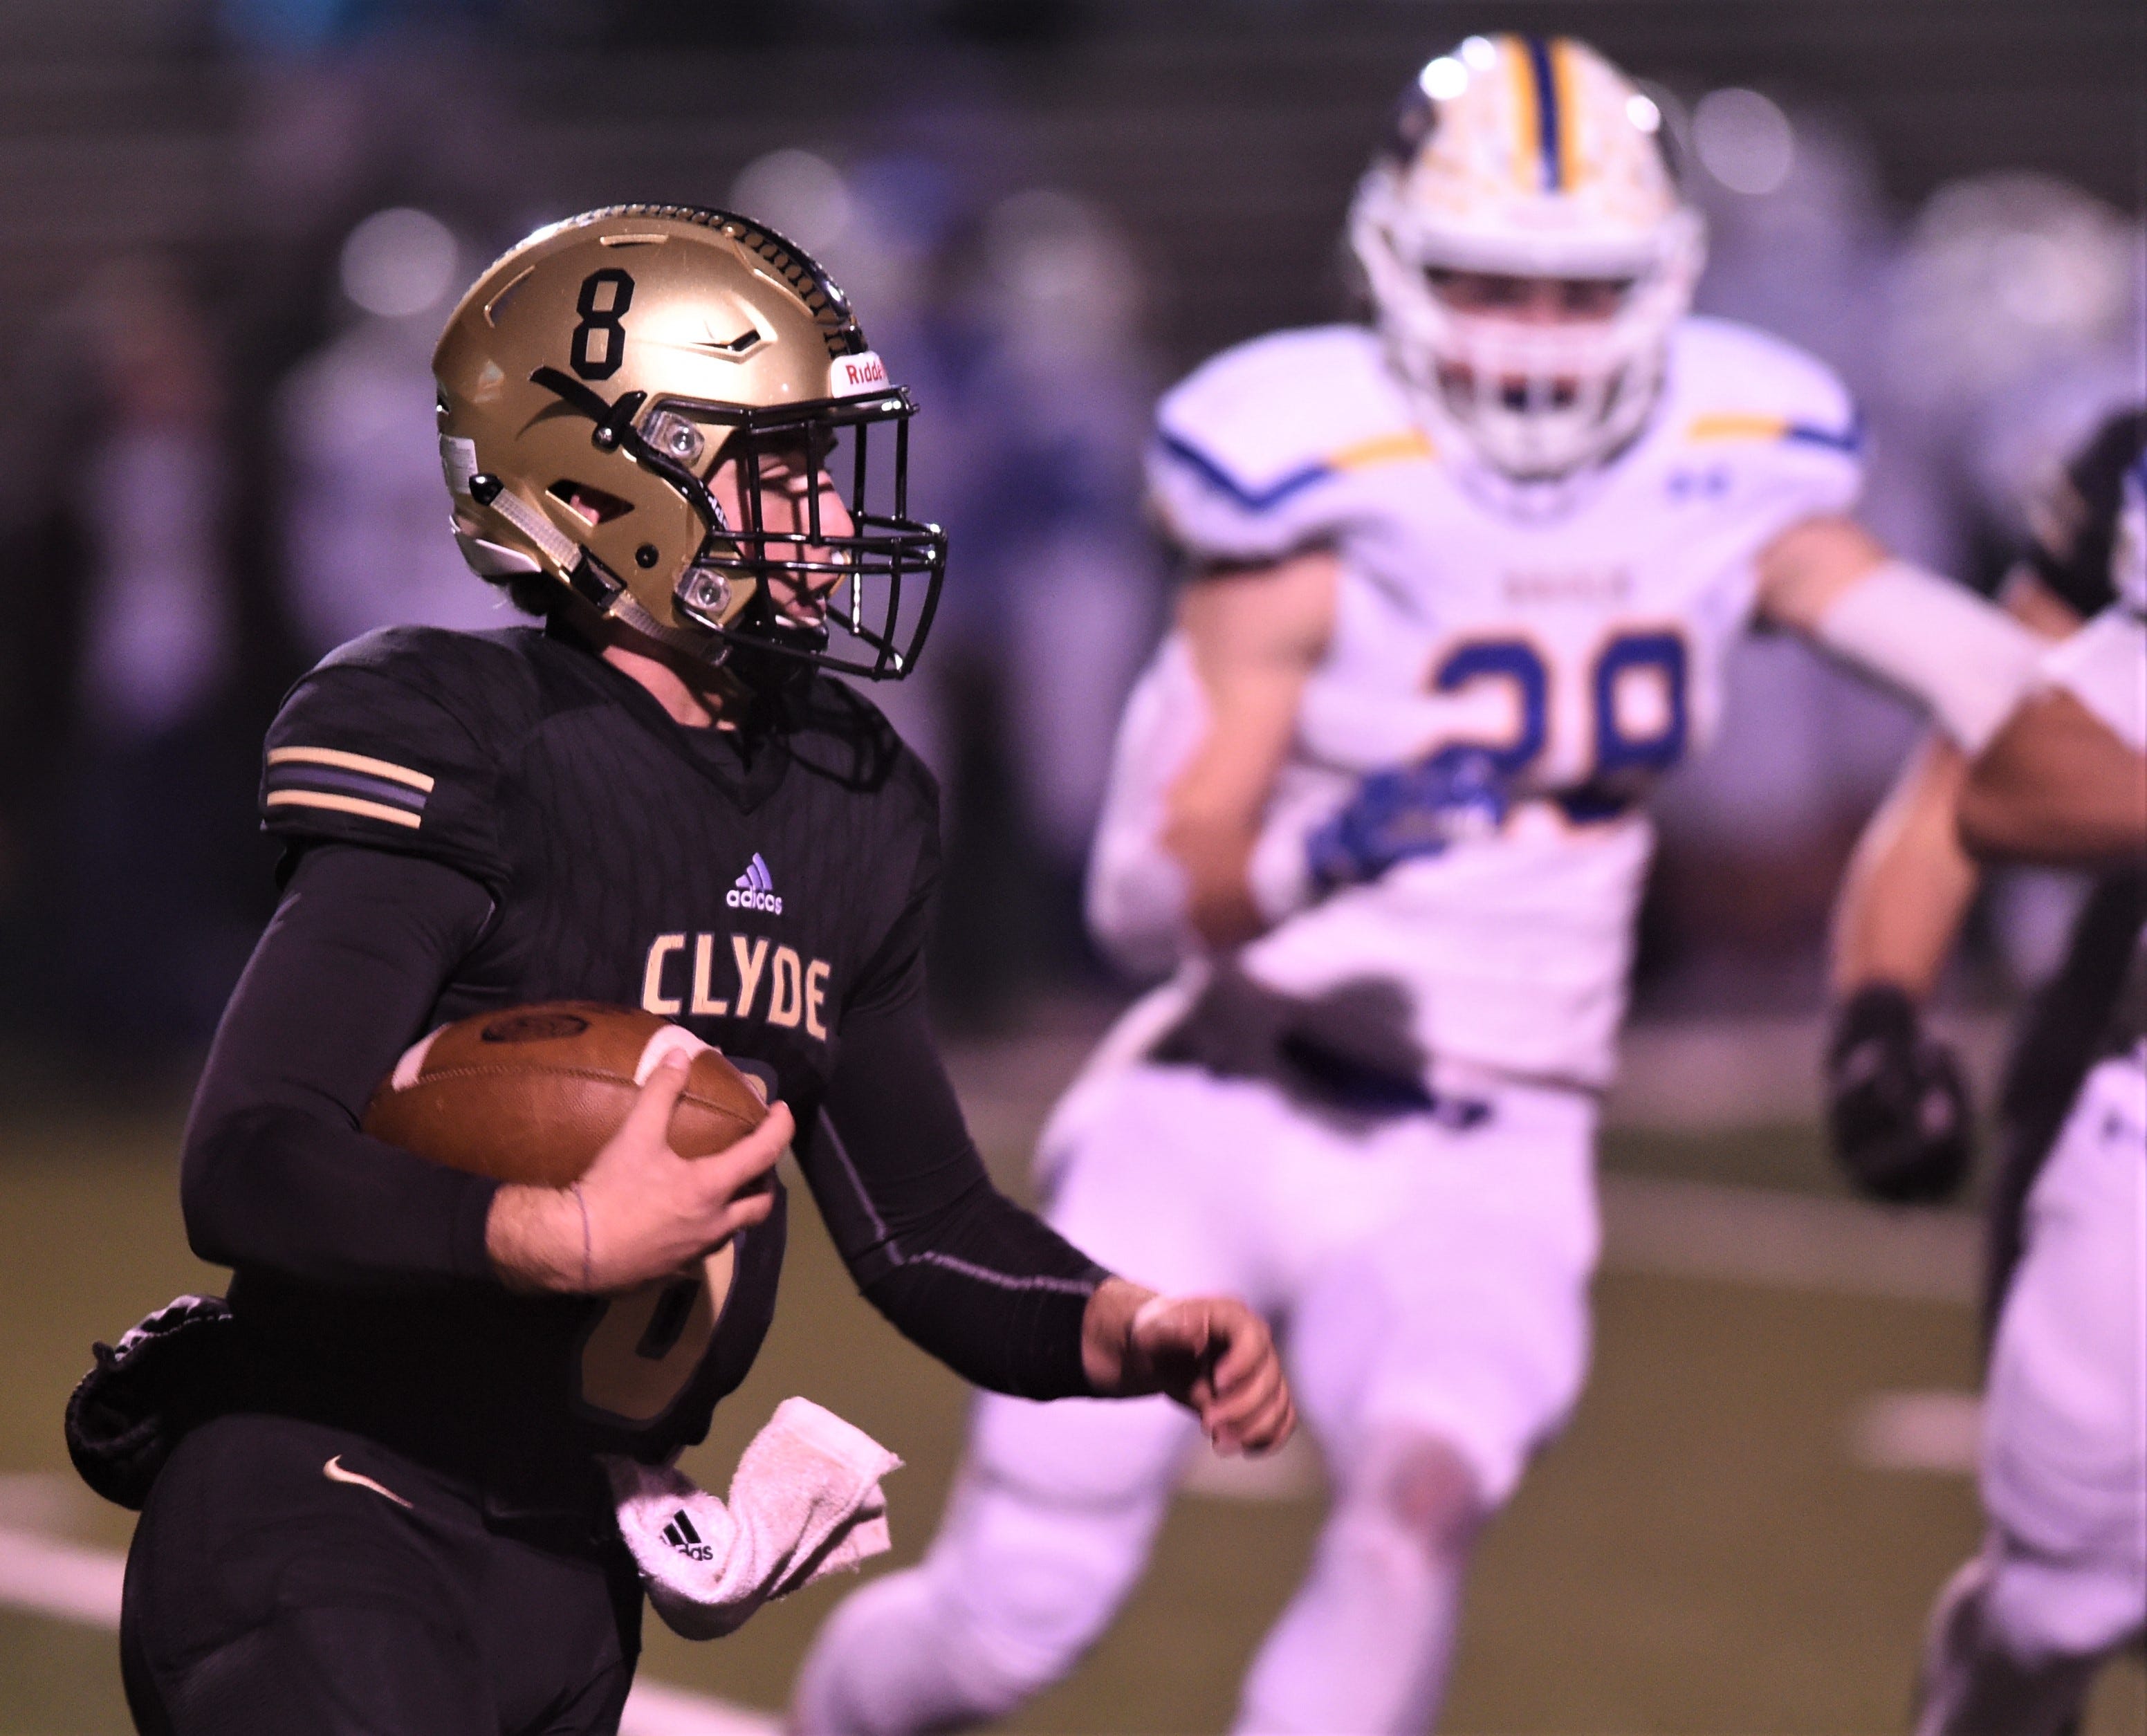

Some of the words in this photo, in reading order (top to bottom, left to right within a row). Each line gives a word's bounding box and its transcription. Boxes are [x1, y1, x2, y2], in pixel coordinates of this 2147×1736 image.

[570, 267, 636, 380] 8
[726, 885, 782, 916] adidas
[641, 932, 831, 1042] CLYDE
